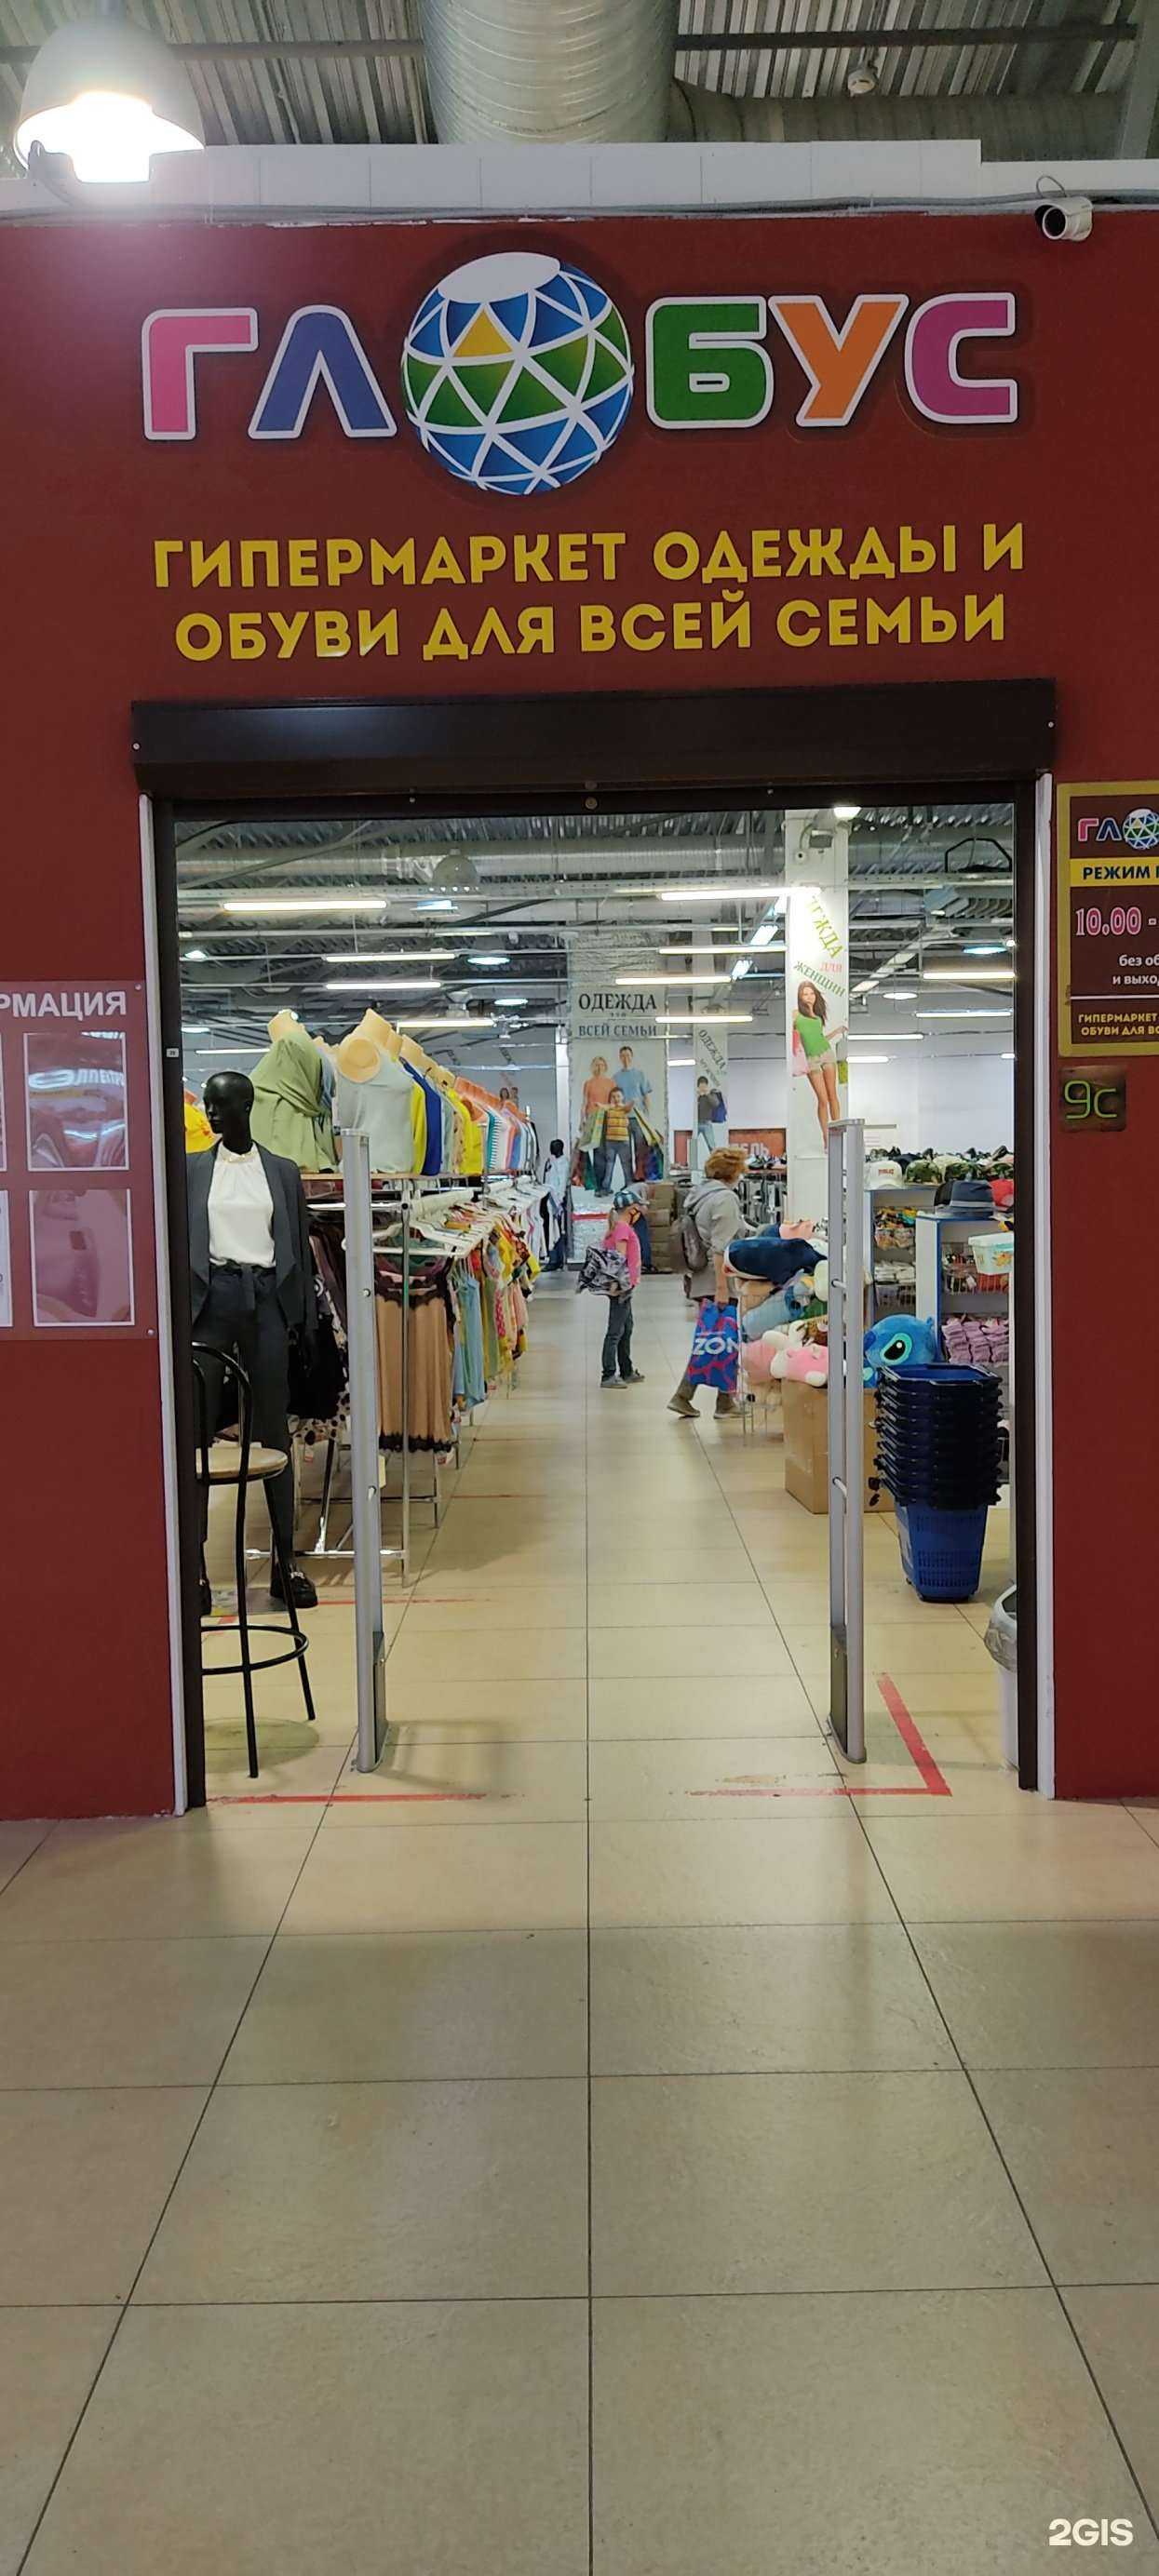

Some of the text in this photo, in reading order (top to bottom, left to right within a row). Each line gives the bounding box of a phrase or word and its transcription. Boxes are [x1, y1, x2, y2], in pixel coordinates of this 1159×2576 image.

[142, 251, 1019, 495] ГЛОБУС
[154, 522, 1024, 589] ГИПЕРМАРКЕТ ОДЕЖДЫ И
[175, 588, 1006, 662] ОБУВИ ДЛЯ ВСЕЙ СЕМЬИ
[1083, 865, 1151, 880] РЕЖИМ
[1075, 906, 1142, 936] 10.00
[1119, 954, 1142, 967] без
[793, 960, 846, 998] ЖЕНЩИН
[1112, 974, 1159, 986] и выхо
[578, 993, 657, 1013] ОДЕЖДА
[1078, 1013, 1158, 1023] ГИПЕРМАРКЕТ
[578, 1023, 657, 1037] ВСЕЙ СЕМЬИ
[1081, 1026, 1119, 1036] ОБУВИ
[1122, 1026, 1145, 1035] ДЛЯ
